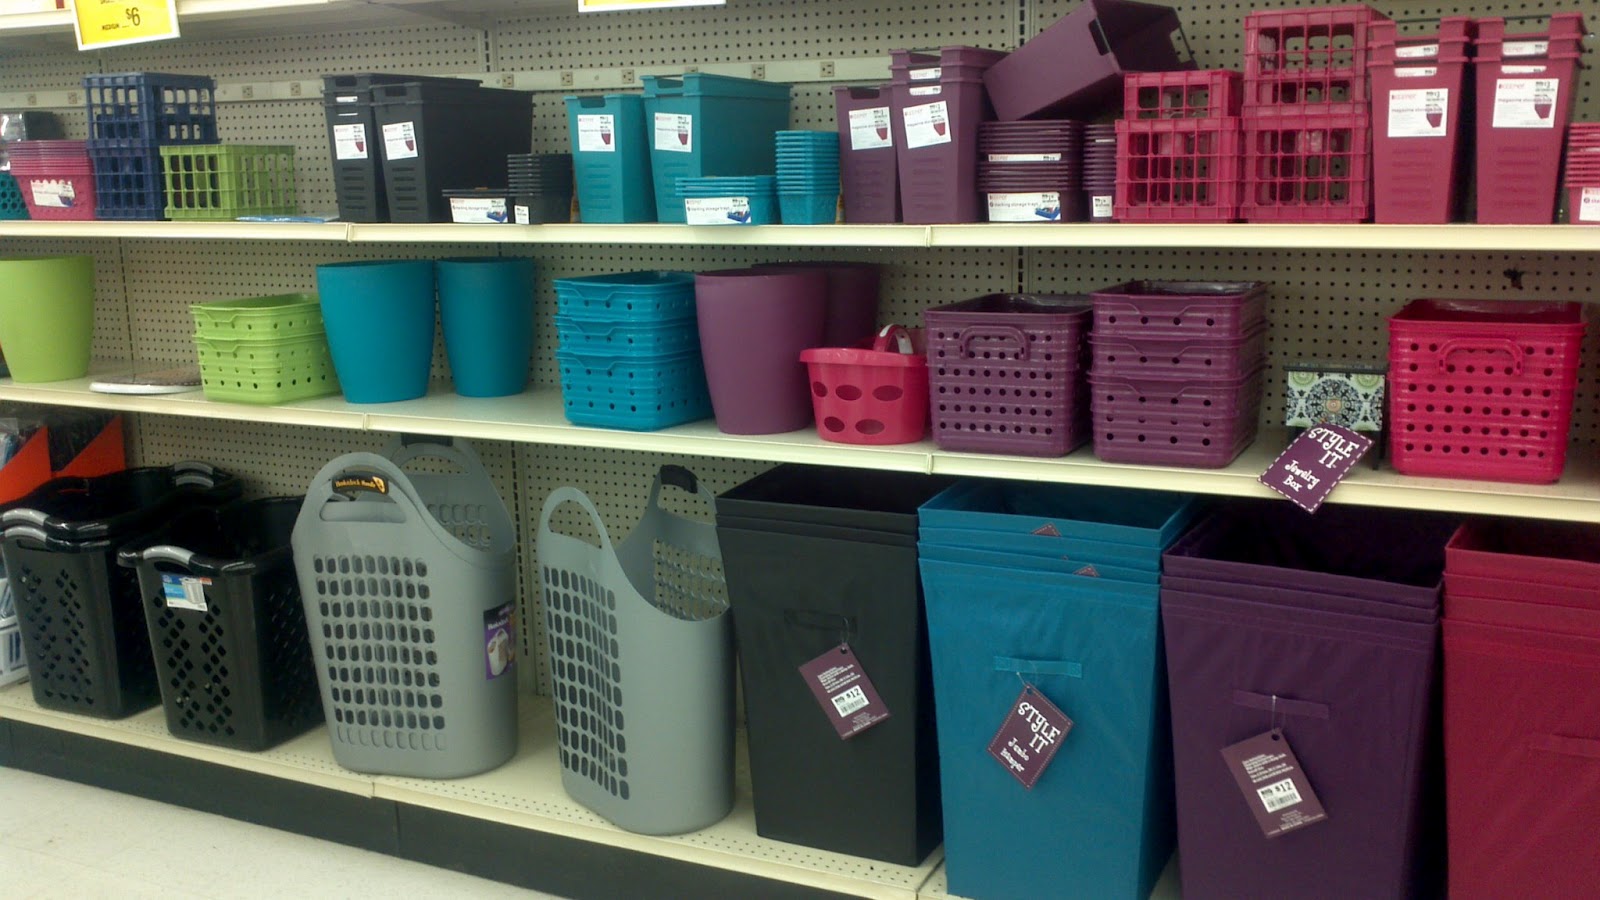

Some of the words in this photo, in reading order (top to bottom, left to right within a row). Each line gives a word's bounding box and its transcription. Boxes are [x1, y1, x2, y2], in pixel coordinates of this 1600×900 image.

[125, 7, 141, 26] $6
[1308, 427, 1360, 458] STYLE
[1318, 450, 1343, 468] IT
[1283, 475, 1302, 492] Box
[1284, 459, 1320, 490] Jewelry
[846, 688, 861, 699] $12
[1017, 701, 1061, 744] STYLE
[1029, 733, 1049, 754] IT
[1274, 781, 1293, 793] $12
